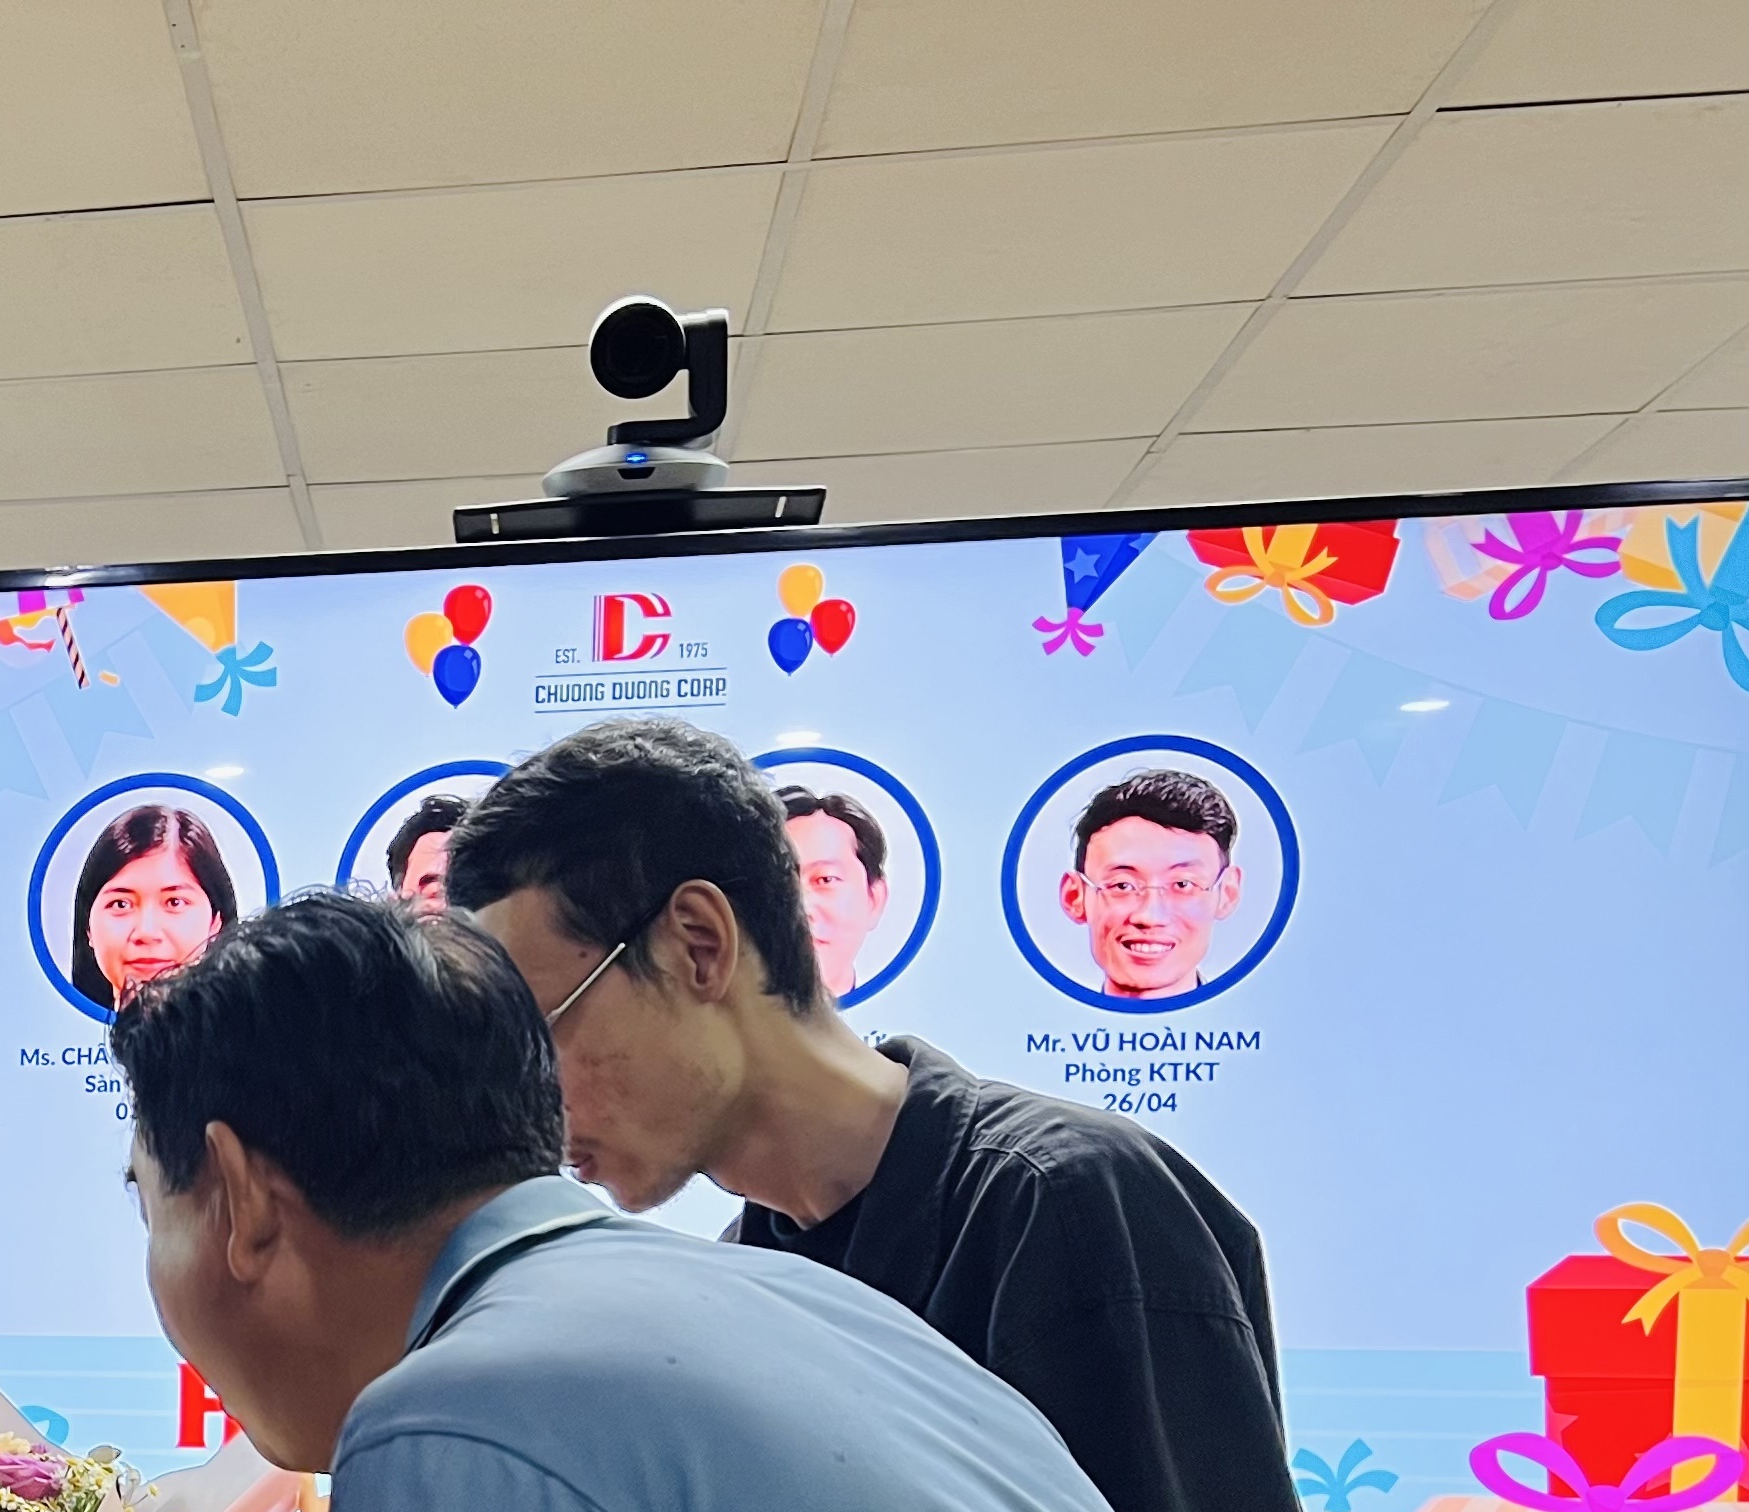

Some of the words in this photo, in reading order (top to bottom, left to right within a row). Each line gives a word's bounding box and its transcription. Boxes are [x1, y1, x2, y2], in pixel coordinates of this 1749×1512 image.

[554, 648, 581, 664] EST.
[678, 642, 709, 659] 1975
[534, 682, 606, 704] CHUONG
[612, 679, 671, 701] DUONG
[1026, 1033, 1067, 1054] Mr.
[1072, 1027, 1111, 1053] VŨ
[1118, 1026, 1188, 1053] HOÀI
[1195, 1030, 1261, 1052] NAM
[19, 1048, 56, 1066] Ms.
[61, 1043, 110, 1066] CHÂ
[85, 1074, 122, 1093] Sàn
[1064, 1062, 1142, 1087] Phòng
[1149, 1062, 1220, 1083] KTKT
[1102, 1092, 1178, 1114] 26/04
